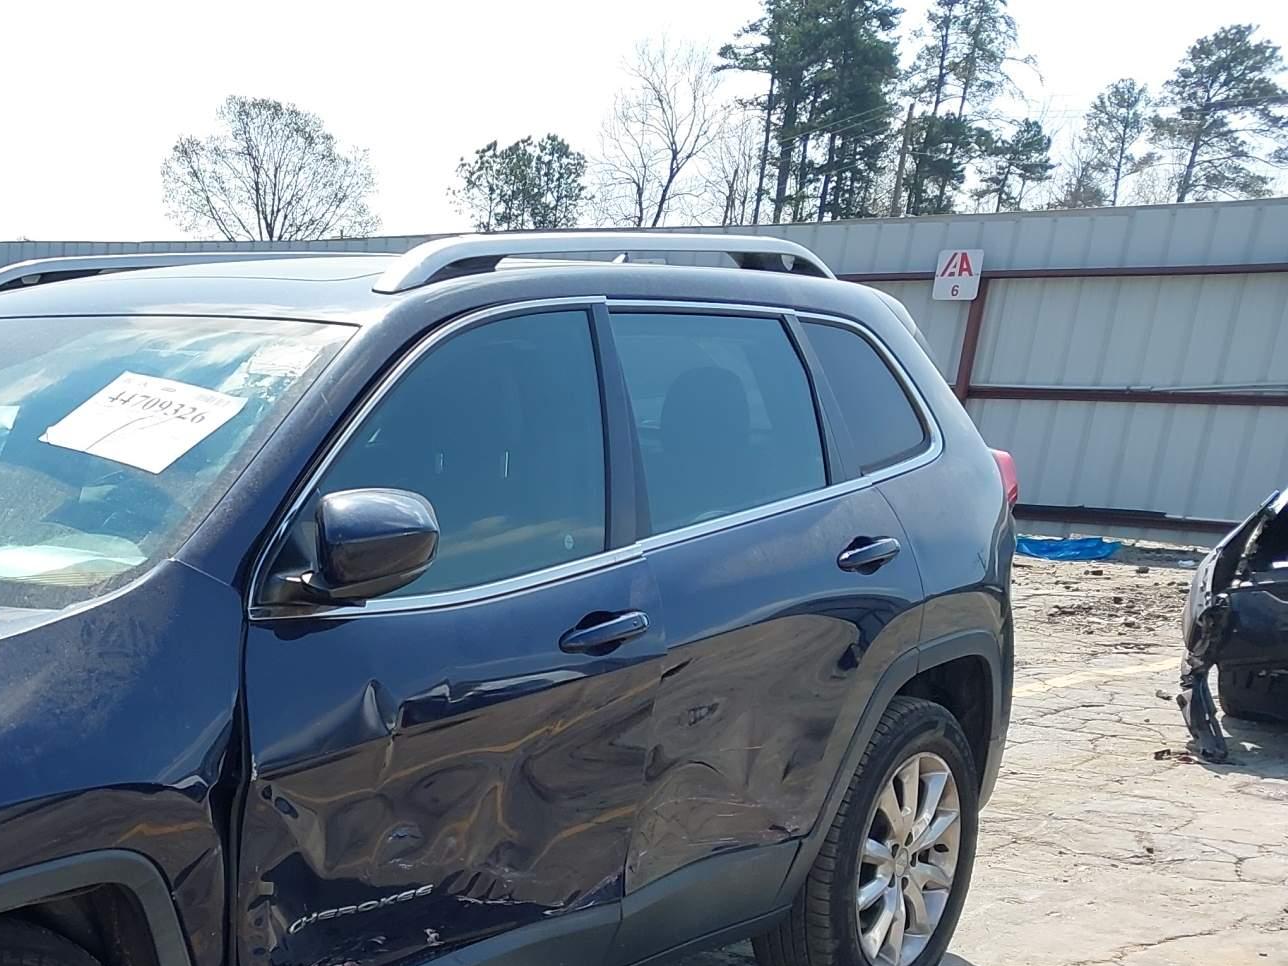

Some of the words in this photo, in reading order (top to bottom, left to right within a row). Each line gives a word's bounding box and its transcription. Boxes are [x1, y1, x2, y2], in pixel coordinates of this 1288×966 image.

[951, 284, 959, 297] 6
[108, 391, 206, 425] 44709326
[287, 884, 434, 935] CHEROKEE
